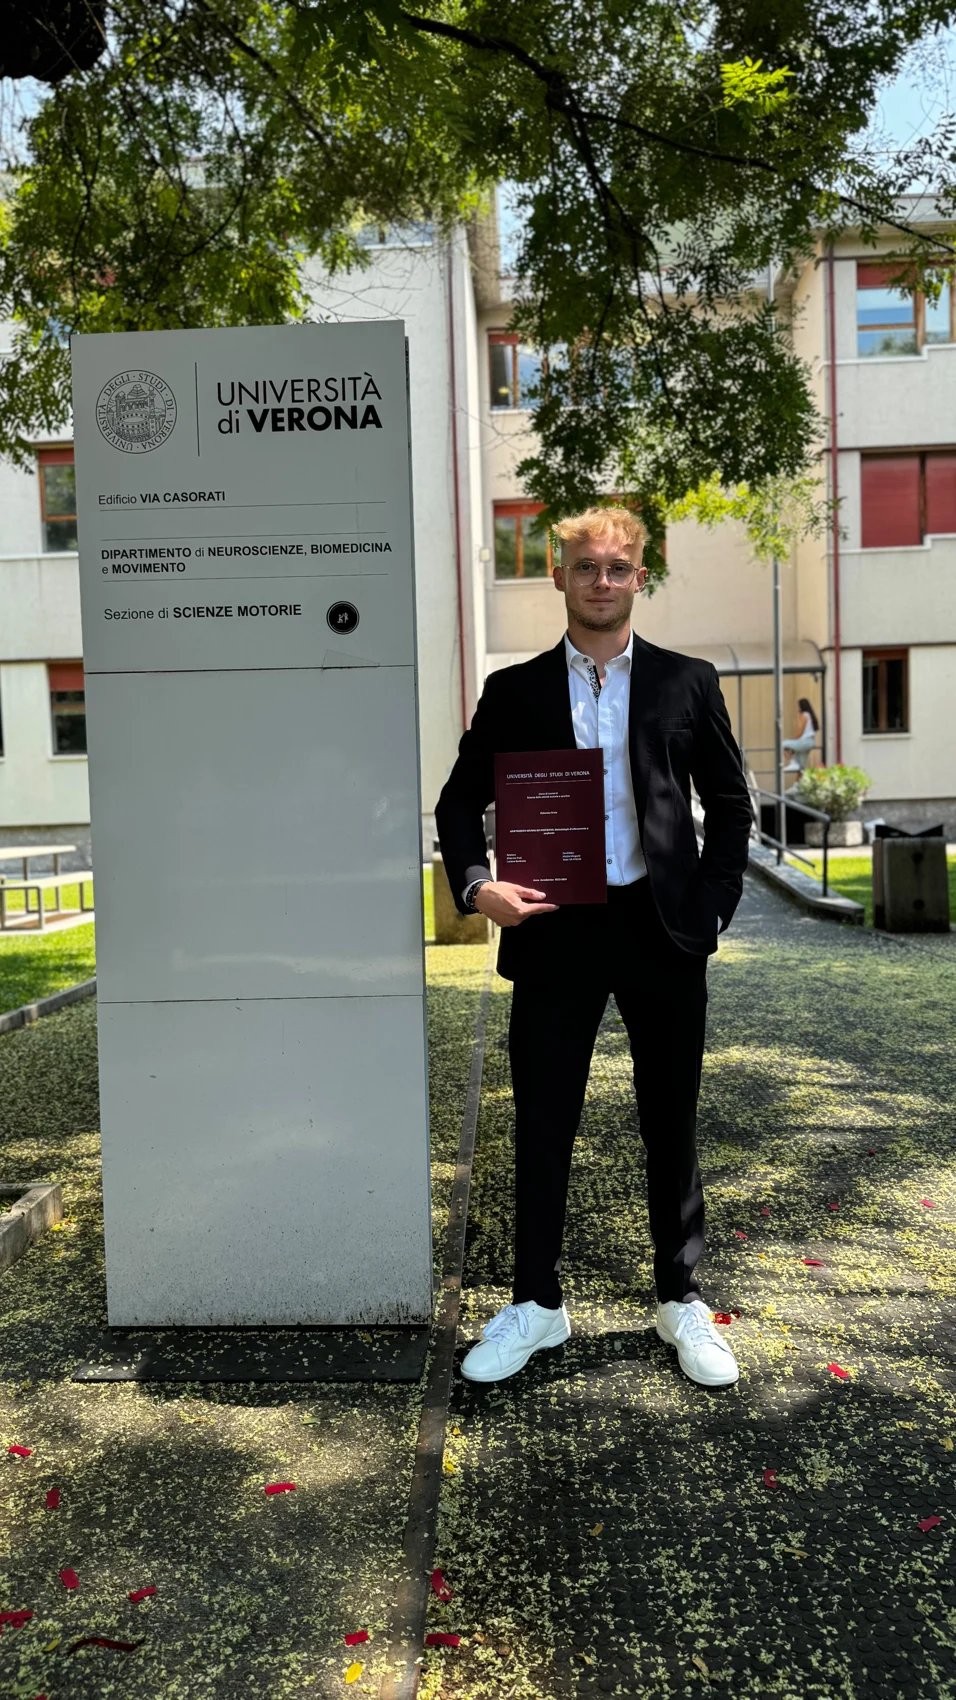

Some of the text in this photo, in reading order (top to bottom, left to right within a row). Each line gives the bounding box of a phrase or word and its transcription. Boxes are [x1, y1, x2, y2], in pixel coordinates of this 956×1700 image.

[103, 373, 130, 397] DEGLI
[138, 372, 167, 394] STUDI
[217, 371, 383, 406] UNIVERSITÀ
[165, 398, 174, 411] DI
[217, 404, 383, 434] di VERONA
[141, 419, 174, 450] VERONA
[98, 491, 226, 505] Edificio VIA CASORATI
[101, 542, 392, 560] DIPARTIMENTO di NEUROSCIENZE, BIOMEDICINA
[101, 562, 186, 574] e MOVIMENTO
[104, 604, 302, 620] Sezione di SCIENZE MOTORIE
